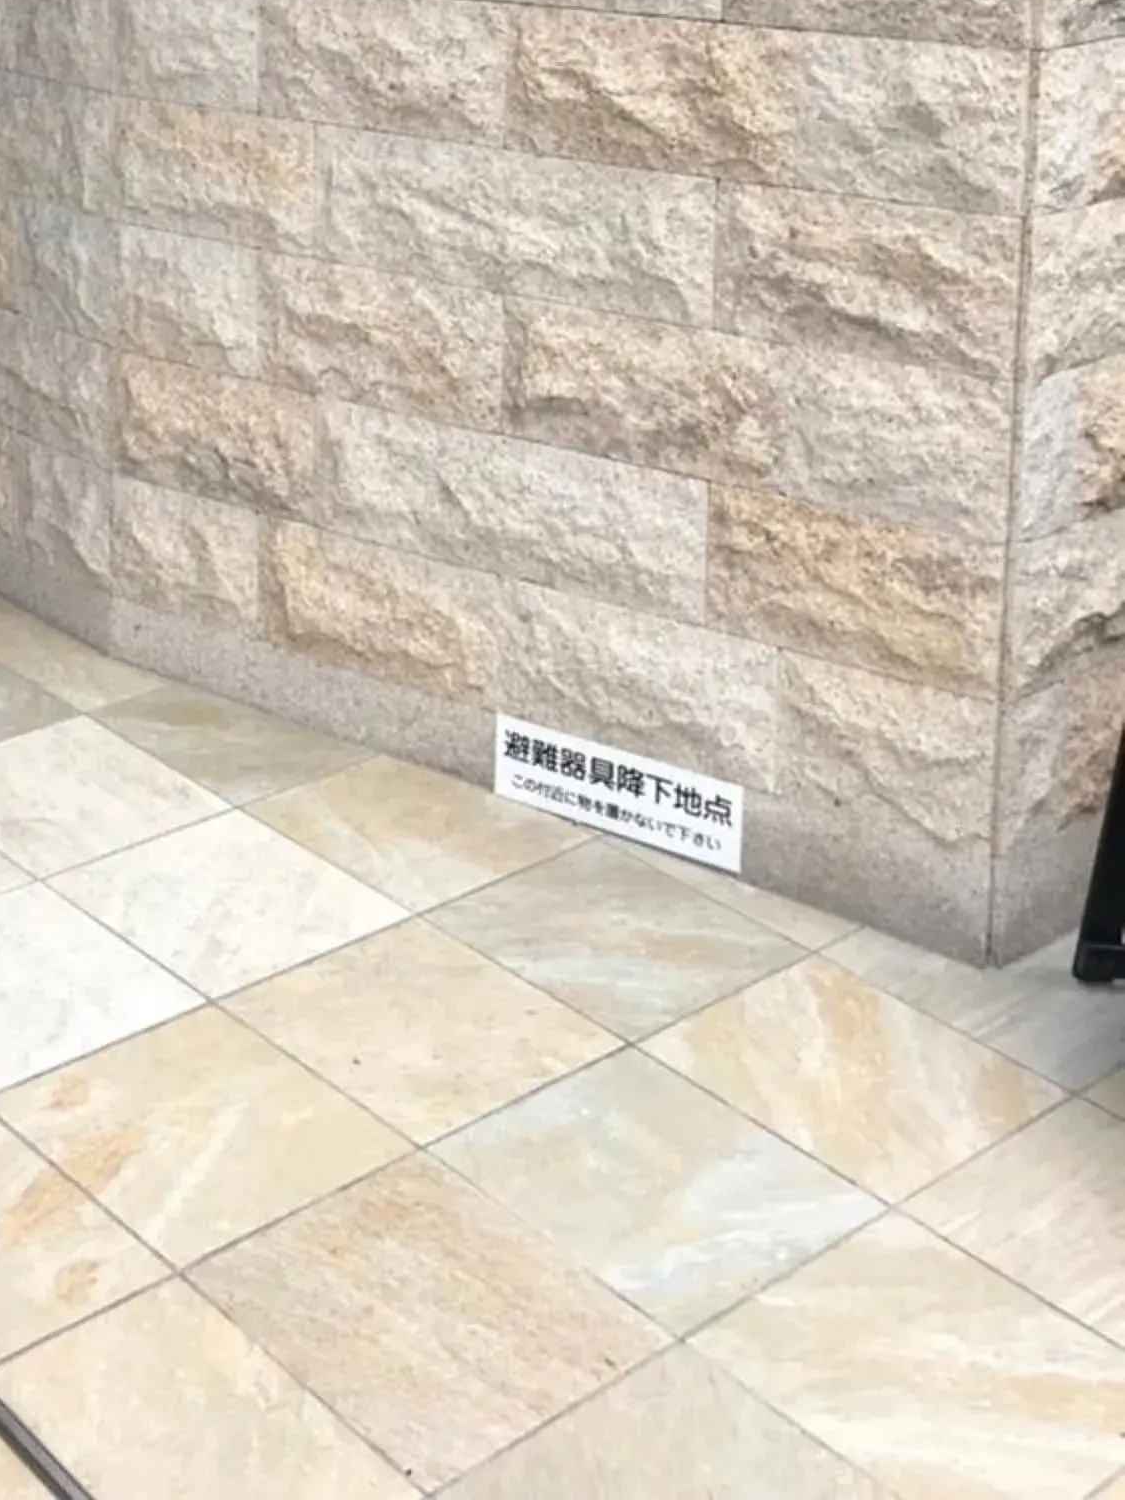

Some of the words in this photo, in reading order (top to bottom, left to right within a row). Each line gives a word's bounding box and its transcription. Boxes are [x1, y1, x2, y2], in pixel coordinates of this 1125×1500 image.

[503, 729, 733, 827] 避難器具降下地点
